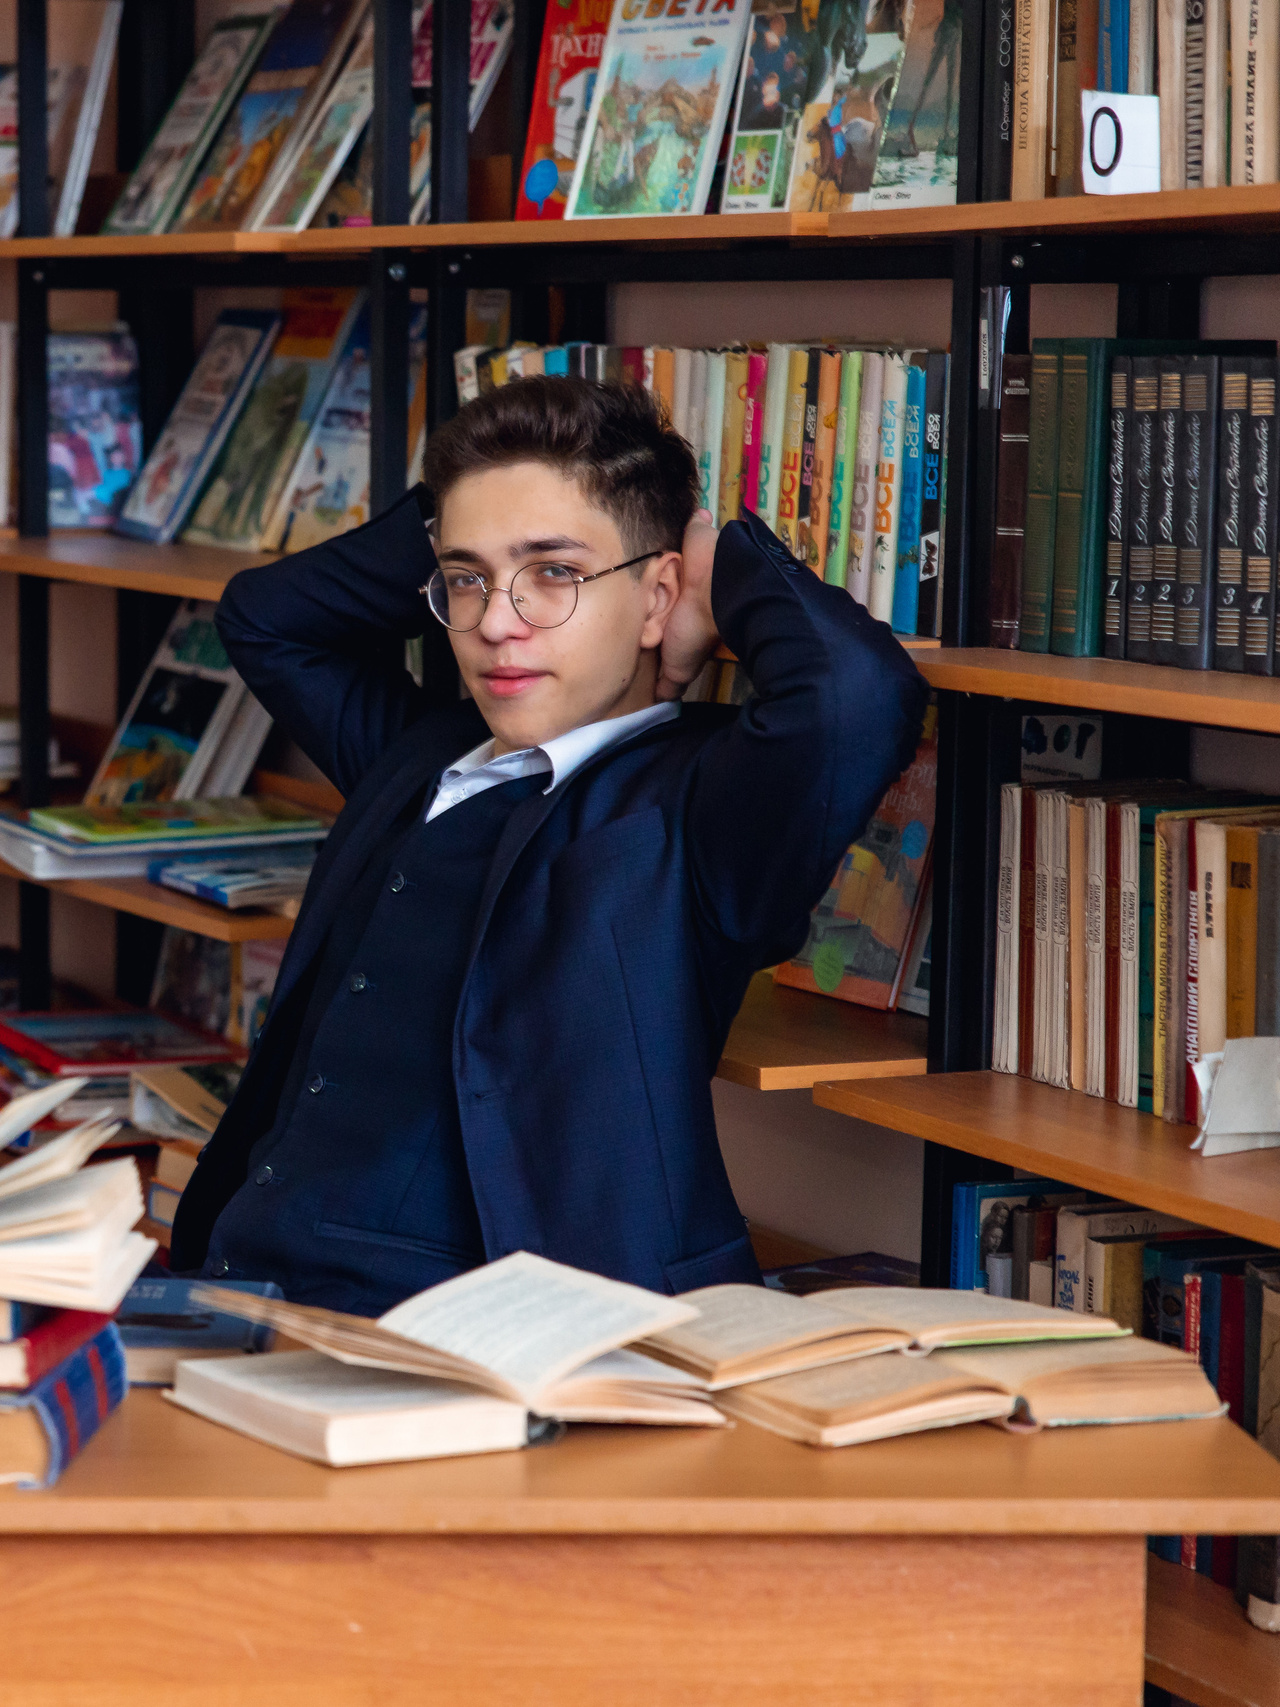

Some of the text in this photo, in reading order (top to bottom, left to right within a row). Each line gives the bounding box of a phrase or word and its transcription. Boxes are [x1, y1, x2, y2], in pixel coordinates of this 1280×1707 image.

[999, 7, 1012, 67] СОРОК
[1246, 50, 1257, 117] НИЛИН
[1018, 90, 1029, 150] ШКОЛА
[909, 405, 920, 459] ВСЕМ
[932, 413, 941, 450] ВСЕМ
[778, 451, 799, 520] ВСЕ
[802, 441, 815, 486] ВСЕ
[875, 399, 897, 534] ВСЕ ВСЕМ
[925, 453, 939, 500] ВСЕ
[852, 464, 870, 532] ВСЕ
[1109, 486, 1123, 539] Джон
[1159, 488, 1174, 542] Джон
[1225, 491, 1240, 546] Джон
[1253, 497, 1268, 554] Джон
[1108, 579, 1119, 597] 1
[1134, 584, 1146, 601] 2
[1158, 584, 1171, 601] 2
[1183, 587, 1195, 605] 3
[1223, 587, 1236, 605] 3
[1251, 596, 1264, 614] 4
[1159, 941, 1167, 950] В
[1159, 950, 1167, 987] МИЛЬ
[1185, 890, 1199, 1066] АНАТОЛИЙ СОФРОНОВ
[1158, 990, 1167, 1039] ТЫСЯЧА
